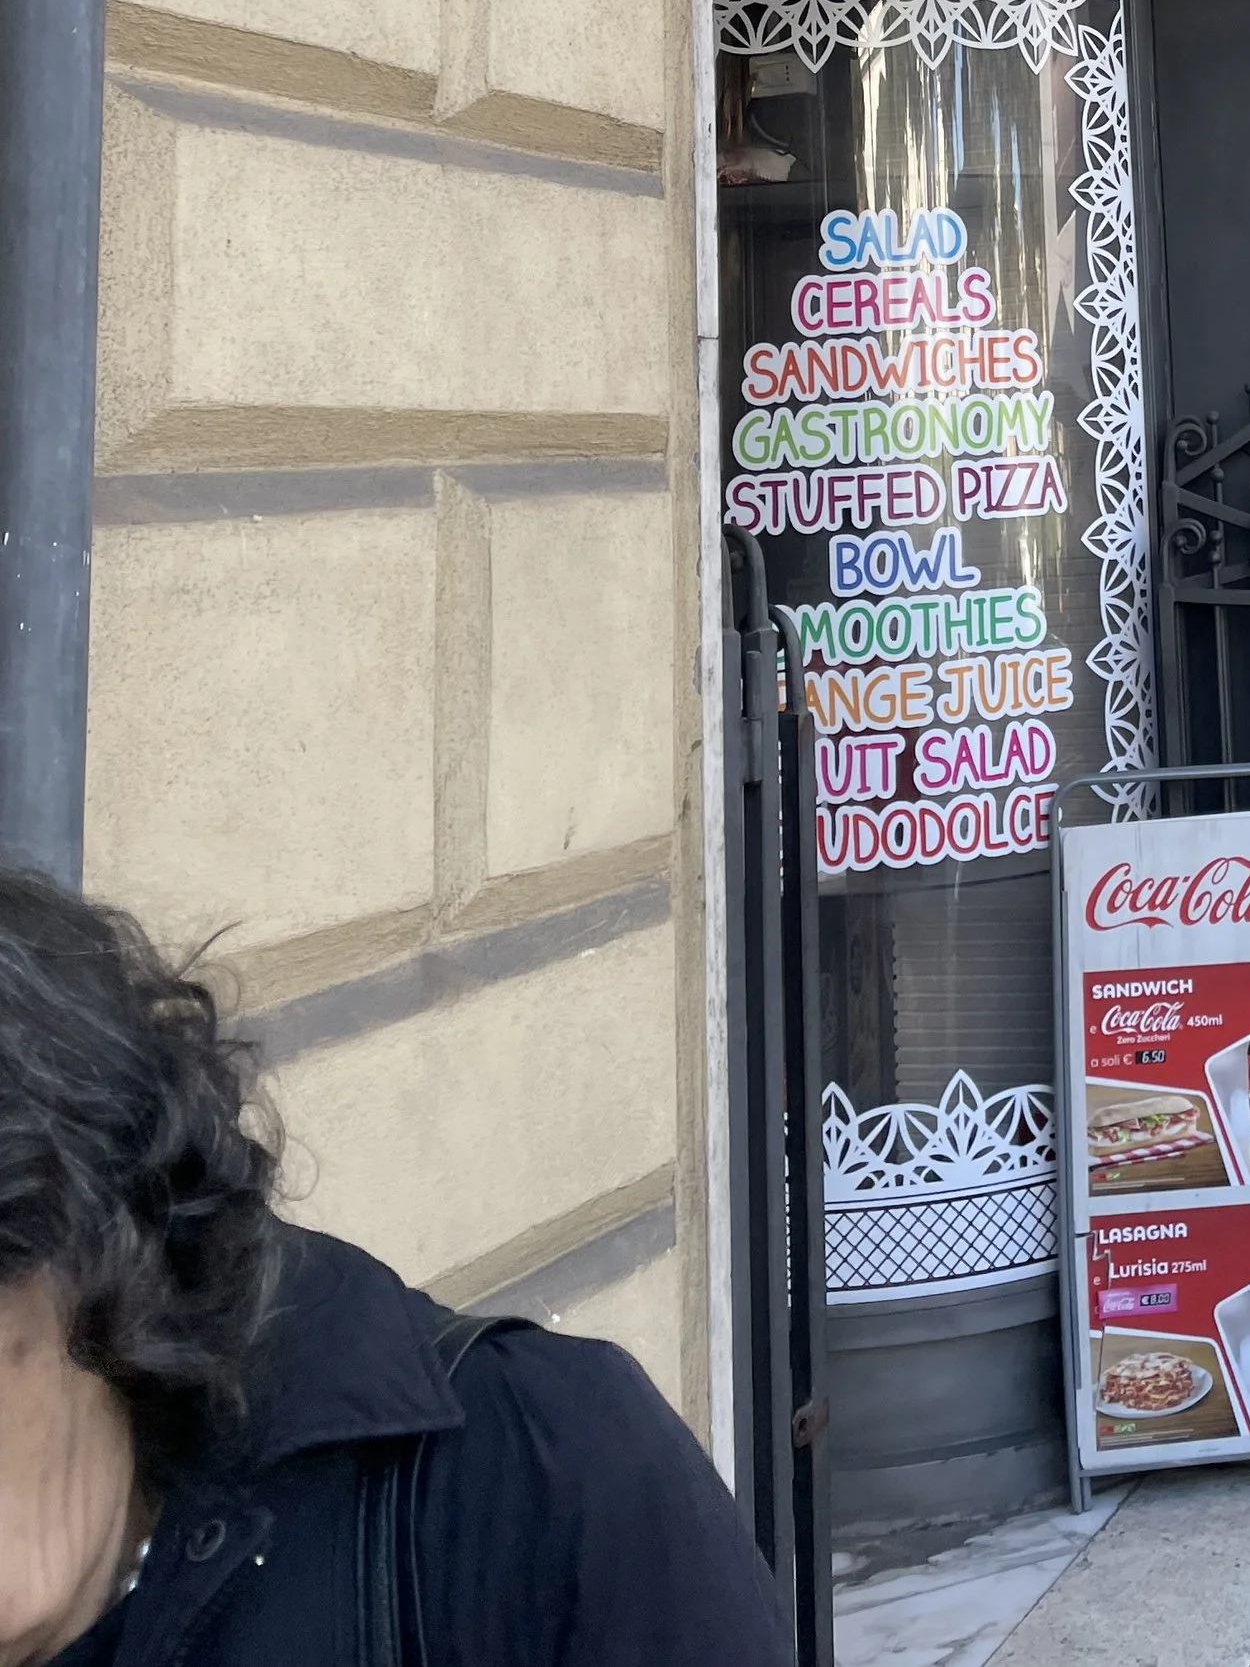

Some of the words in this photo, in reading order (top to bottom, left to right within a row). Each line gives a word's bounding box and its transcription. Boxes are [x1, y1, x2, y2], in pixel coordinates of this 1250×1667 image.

[825, 211, 963, 266] SALAD
[797, 273, 991, 331] CEREALS
[747, 334, 1039, 400] SANDWICHES
[739, 397, 1049, 465] GASTRONOMY
[731, 470, 940, 531] STUFFED
[957, 461, 1064, 515] PIZZA
[836, 533, 976, 591] BOWL
[777, 592, 1043, 660] MOOTHIES
[777, 669, 927, 727] ANGE
[938, 655, 1070, 718] JUICE
[820, 741, 900, 798] UIT
[920, 726, 1052, 790] SALAD
[817, 791, 1056, 868] UDODOLCE
[1089, 1025, 1097, 1034] e
[1101, 1002, 1184, 1035] Coca-Cola
[1186, 1014, 1223, 1027] 450ml
[1092, 979, 1193, 1000] SANDWICH
[1090, 1058, 1099, 1068] a
[1102, 1055, 1121, 1066] soli
[1123, 1054, 1133, 1065] €
[1141, 1050, 1166, 1064] 6.50
[1116, 1035, 1136, 1045] Zero
[1136, 1033, 1171, 1044] Zuccheri
[1099, 1223, 1188, 1244] LASAGNA
[1093, 1276, 1101, 1285] e
[1109, 1258, 1168, 1279] Lurisia
[1171, 1259, 1207, 1274] 275ml
